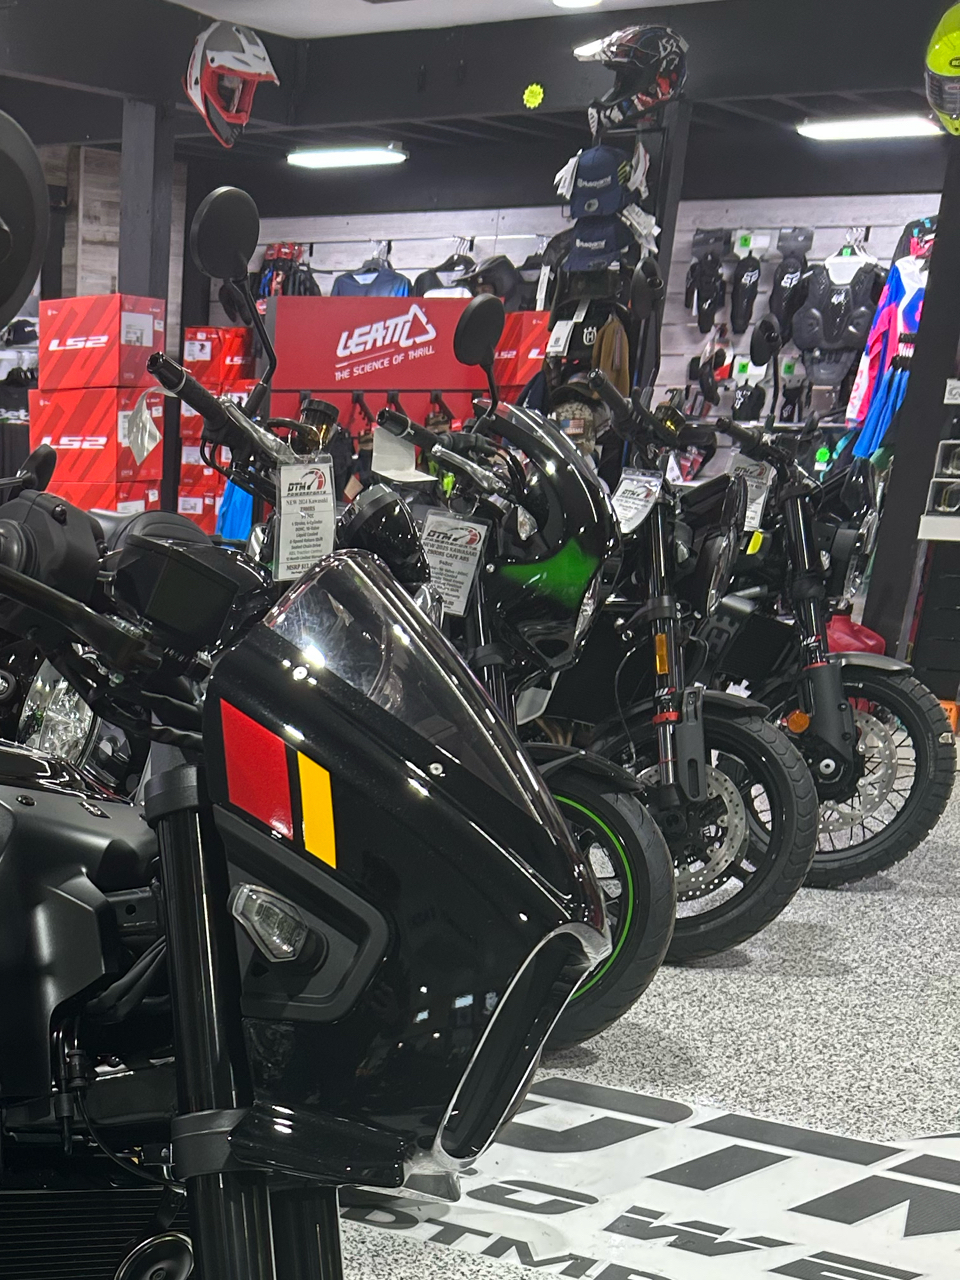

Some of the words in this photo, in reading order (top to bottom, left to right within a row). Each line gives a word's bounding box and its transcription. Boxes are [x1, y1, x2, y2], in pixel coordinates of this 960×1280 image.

[48, 335, 109, 351] LS2
[335, 369, 350, 381] THE
[353, 357, 390, 376] SCIENCE
[392, 353, 405, 365] OF
[408, 345, 435, 360] THRILL
[40, 436, 108, 450] LS2
